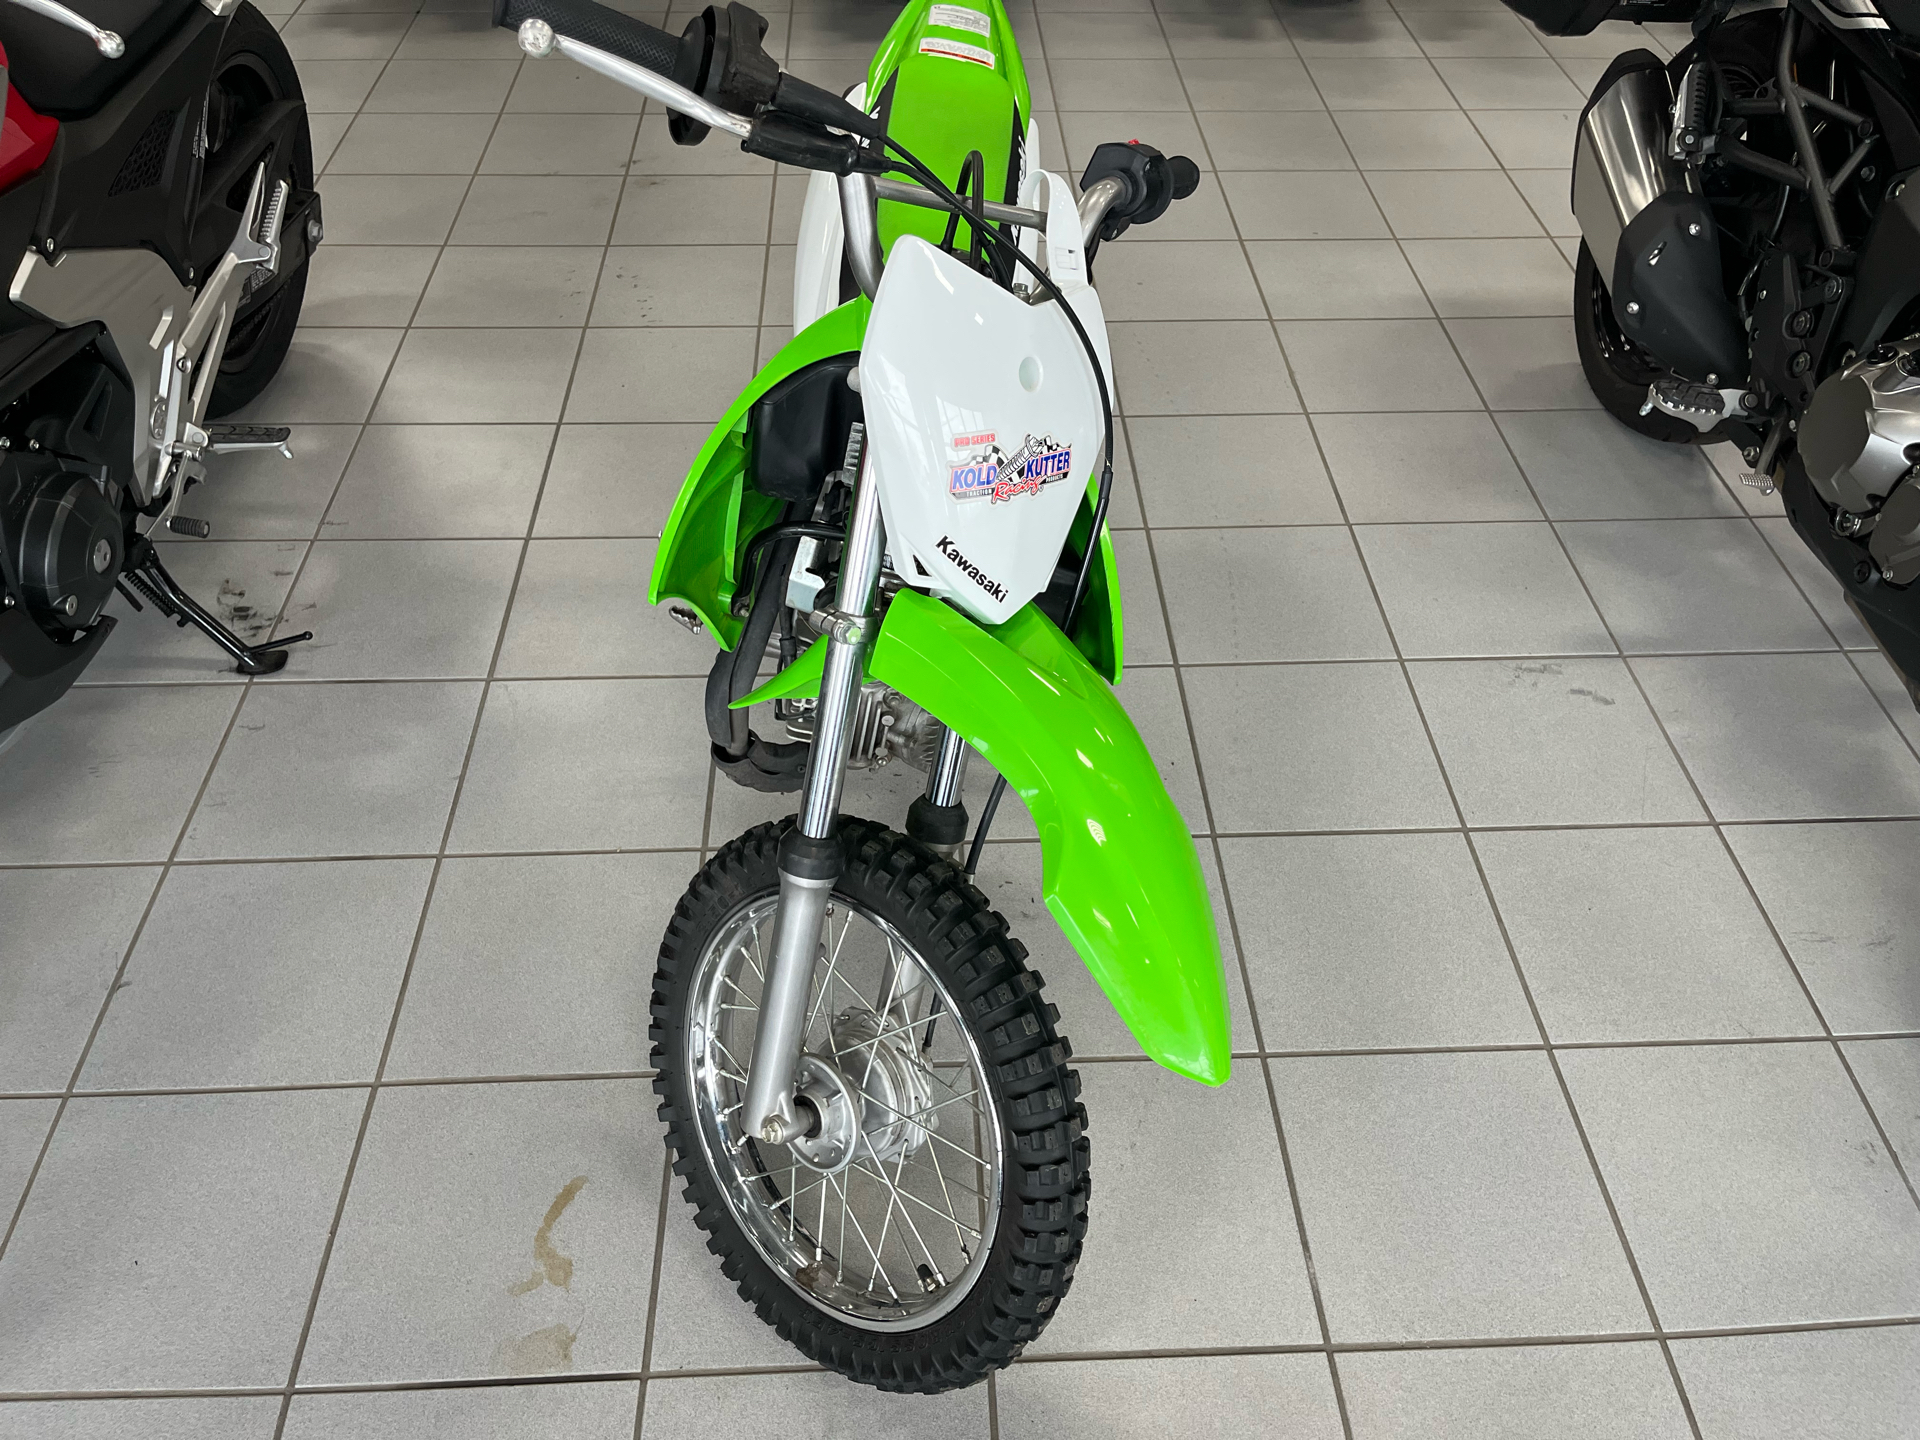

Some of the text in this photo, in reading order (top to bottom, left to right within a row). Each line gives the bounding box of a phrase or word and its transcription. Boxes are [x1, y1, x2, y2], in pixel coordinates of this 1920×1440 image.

[954, 433, 996, 448] PRO SERIES
[952, 450, 1072, 490] KOLD KUTTER
[966, 488, 993, 498] TRACTION
[991, 475, 1046, 504] Racing
[935, 535, 1009, 604] Kawasaki
